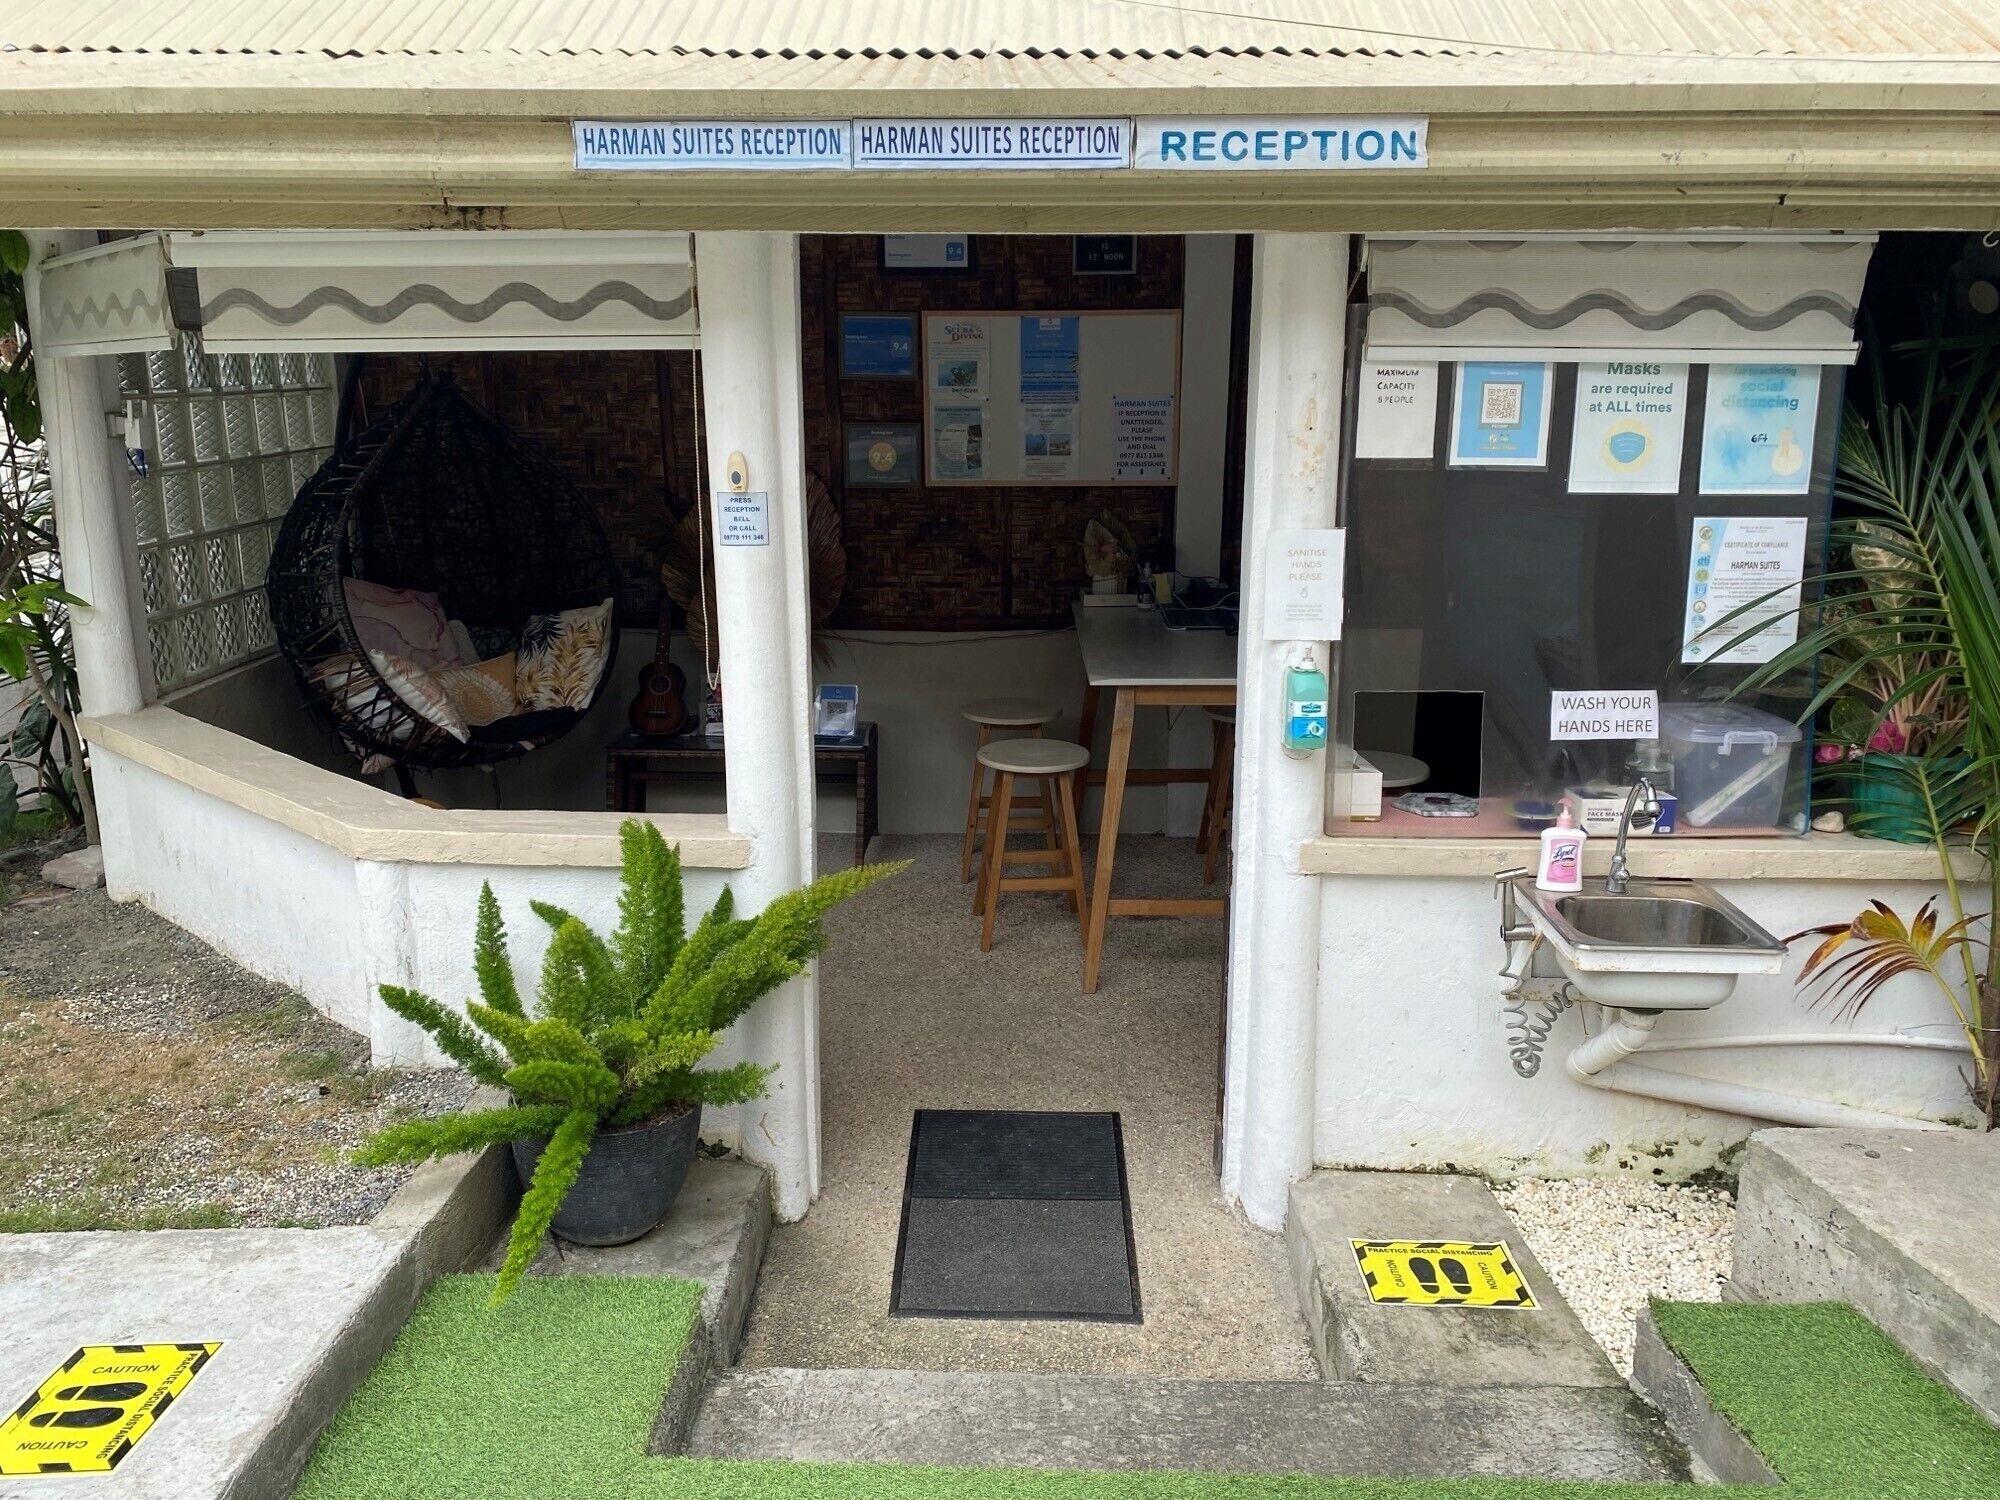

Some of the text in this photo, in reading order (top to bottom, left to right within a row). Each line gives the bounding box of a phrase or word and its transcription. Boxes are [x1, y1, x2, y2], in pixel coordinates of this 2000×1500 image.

[583, 127, 842, 155] HARMAN SUITES RECEPTION
[861, 125, 1120, 154] HARMAN SUITES RECEPTION
[1161, 130, 1417, 162] RECEPTION
[1104, 252, 1124, 261] NOON
[893, 342, 908, 352] 9.4
[1607, 362, 1661, 375] Masks
[1377, 381, 1416, 390] CAPACITY
[1591, 382, 1673, 396] are required
[1740, 380, 1785, 392] social
[1115, 400, 1146, 408] HARMAN
[1385, 396, 1414, 404] PEOPLE
[1721, 395, 1800, 411] distancing
[1589, 400, 1673, 413] at ALL times
[873, 451, 893, 464] 9.4
[1287, 548, 1328, 557] SANITISE
[1291, 561, 1322, 569] HANDS
[1731, 561, 1781, 570] HARMAN SUITES
[1289, 573, 1323, 581] PLEASE
[1561, 696, 1652, 710] WASH YOUR
[1558, 719, 1653, 733] HANDS HERE
[1410, 1247, 1440, 1255] SOCIAL
[1442, 1249, 1493, 1257] DISTANCING
[1386, 1259, 1406, 1288] CAUTION
[1477, 1261, 1499, 1290] CAUTION
[92, 1363, 161, 1375] CAUTION
[96, 1352, 198, 1460] PRACTICE SOCIAL DISTANCING
[16, 1439, 89, 1451] CAUTION
